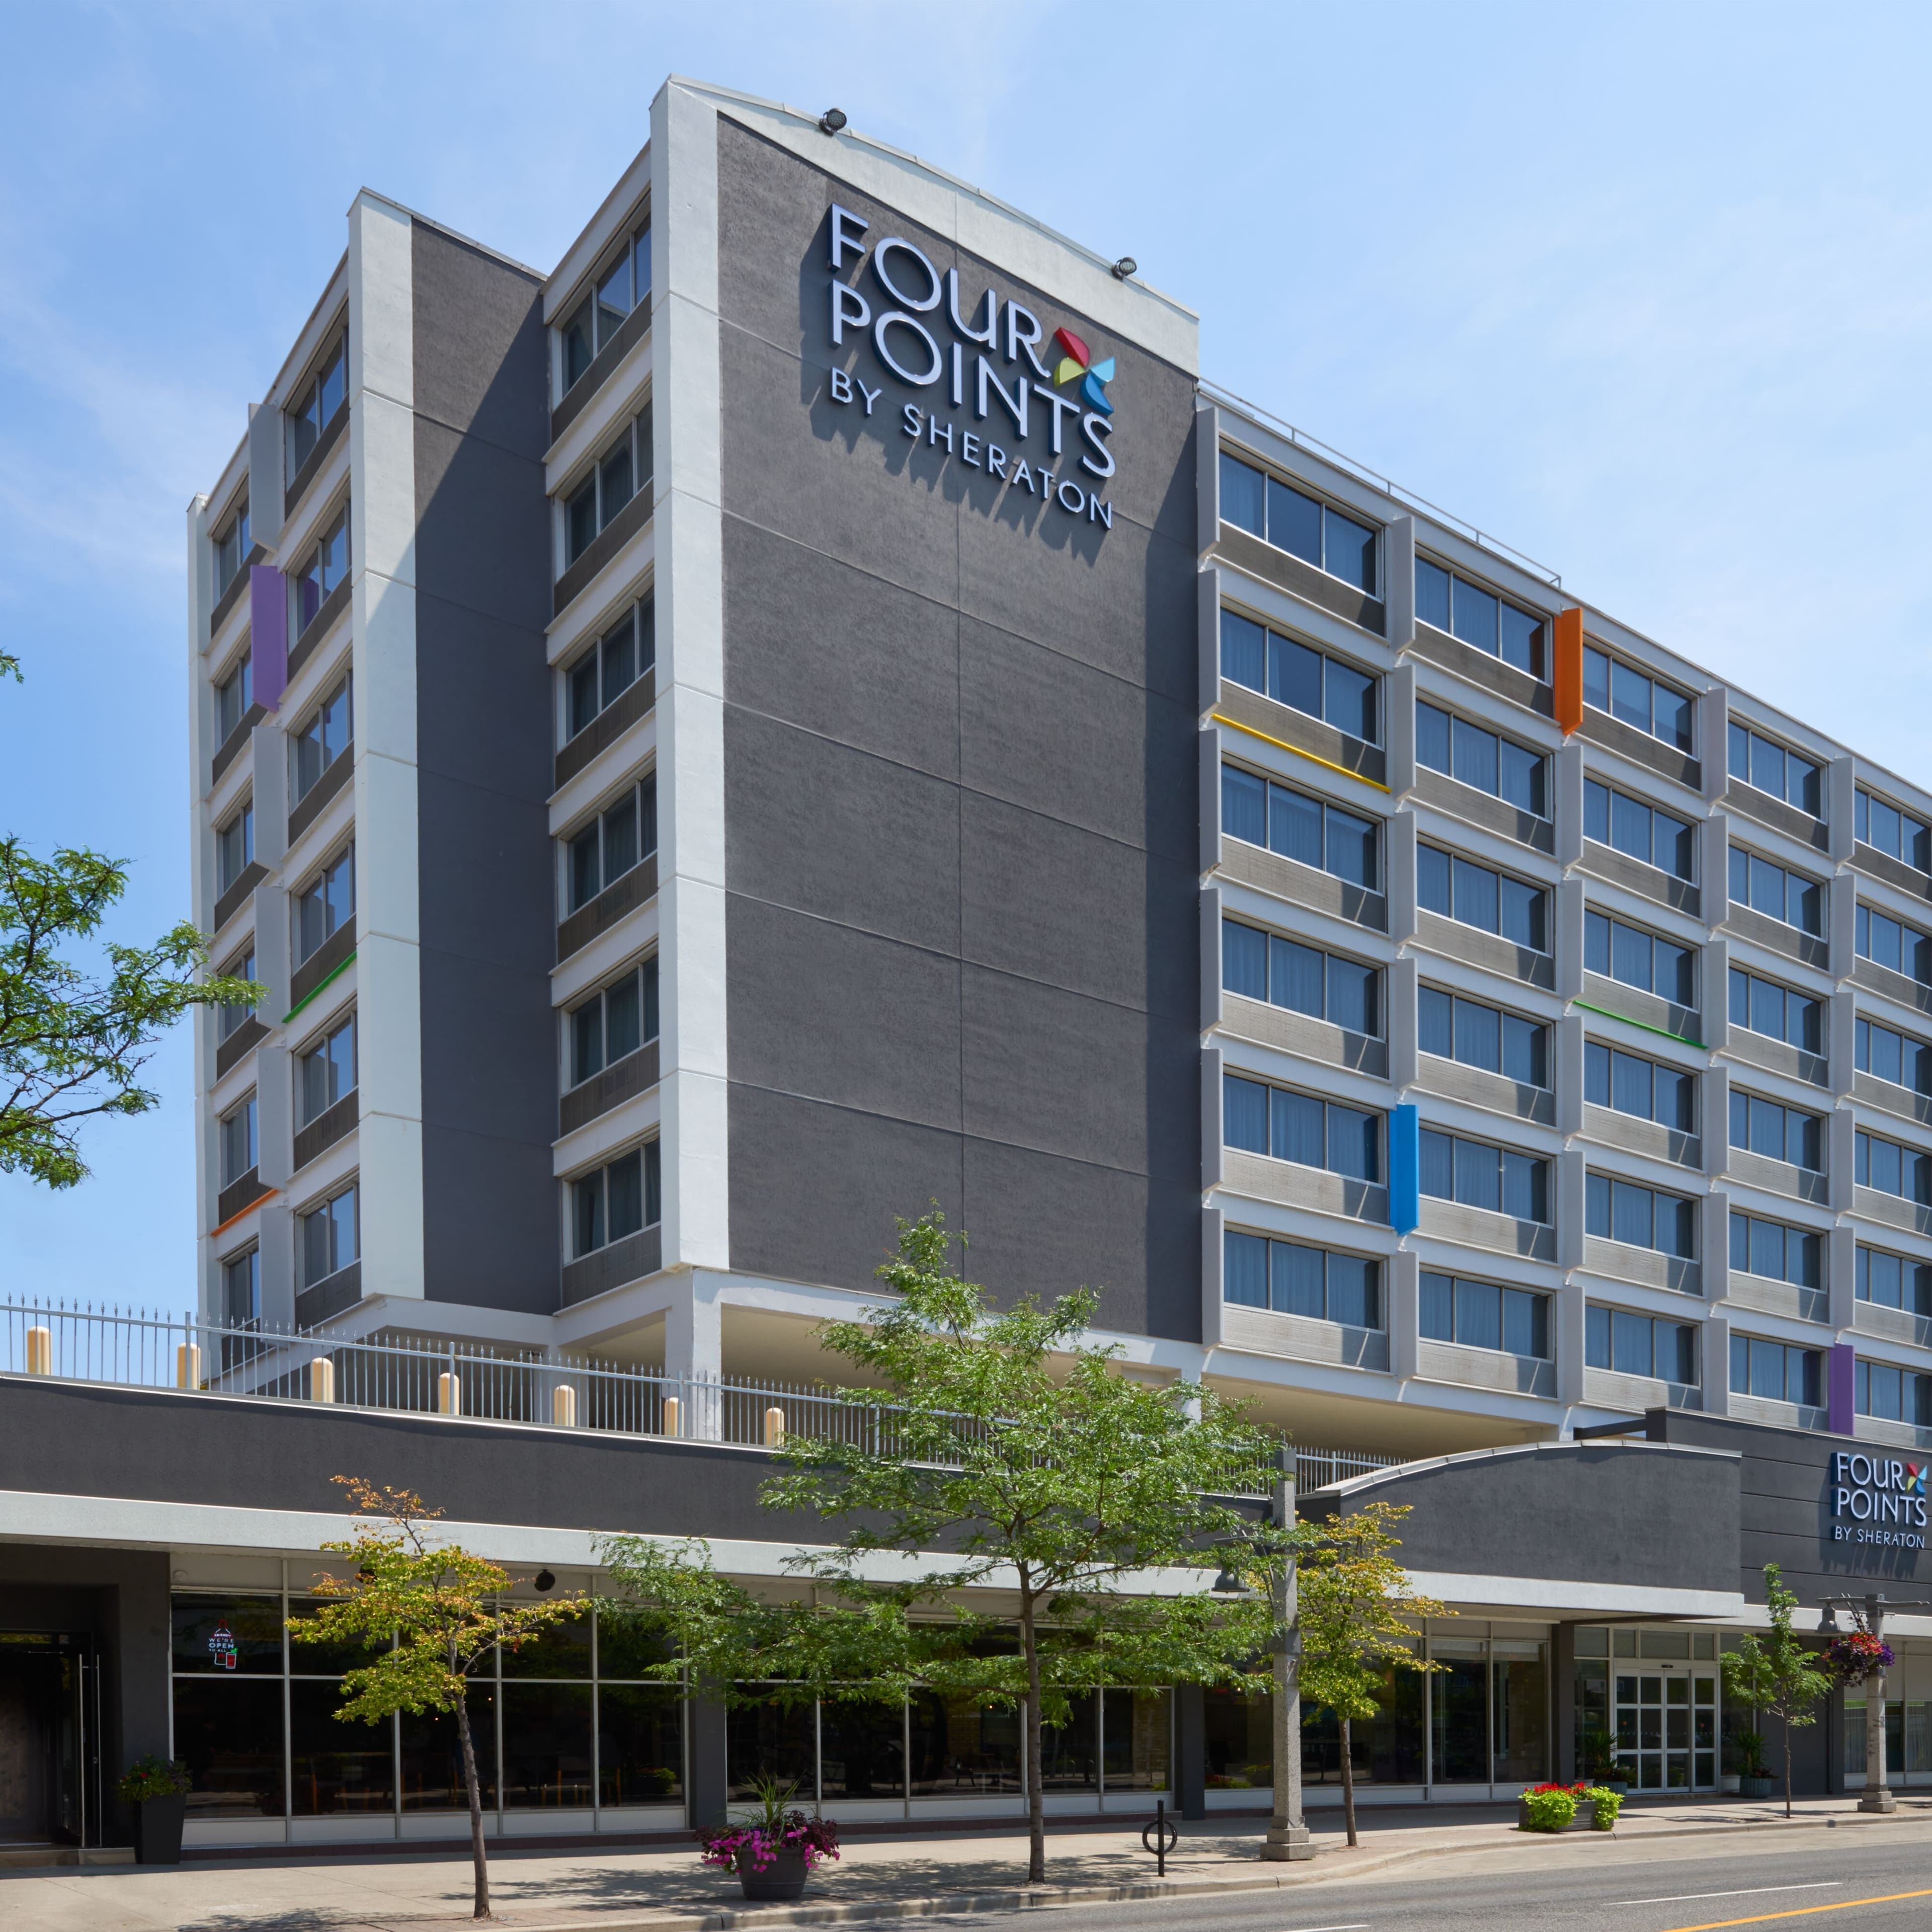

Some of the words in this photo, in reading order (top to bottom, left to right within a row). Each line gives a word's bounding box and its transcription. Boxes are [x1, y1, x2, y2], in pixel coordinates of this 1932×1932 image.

[828, 202, 1051, 380] FOUR
[829, 279, 1116, 479] POINTS
[830, 367, 882, 416] BY
[902, 403, 1112, 530] SHERATON
[1836, 1452, 1906, 1491] FOUR
[1837, 1487, 1927, 1527] POINTS
[1835, 1525, 1852, 1541] BY
[1857, 1528, 1924, 1549] SHERATON
